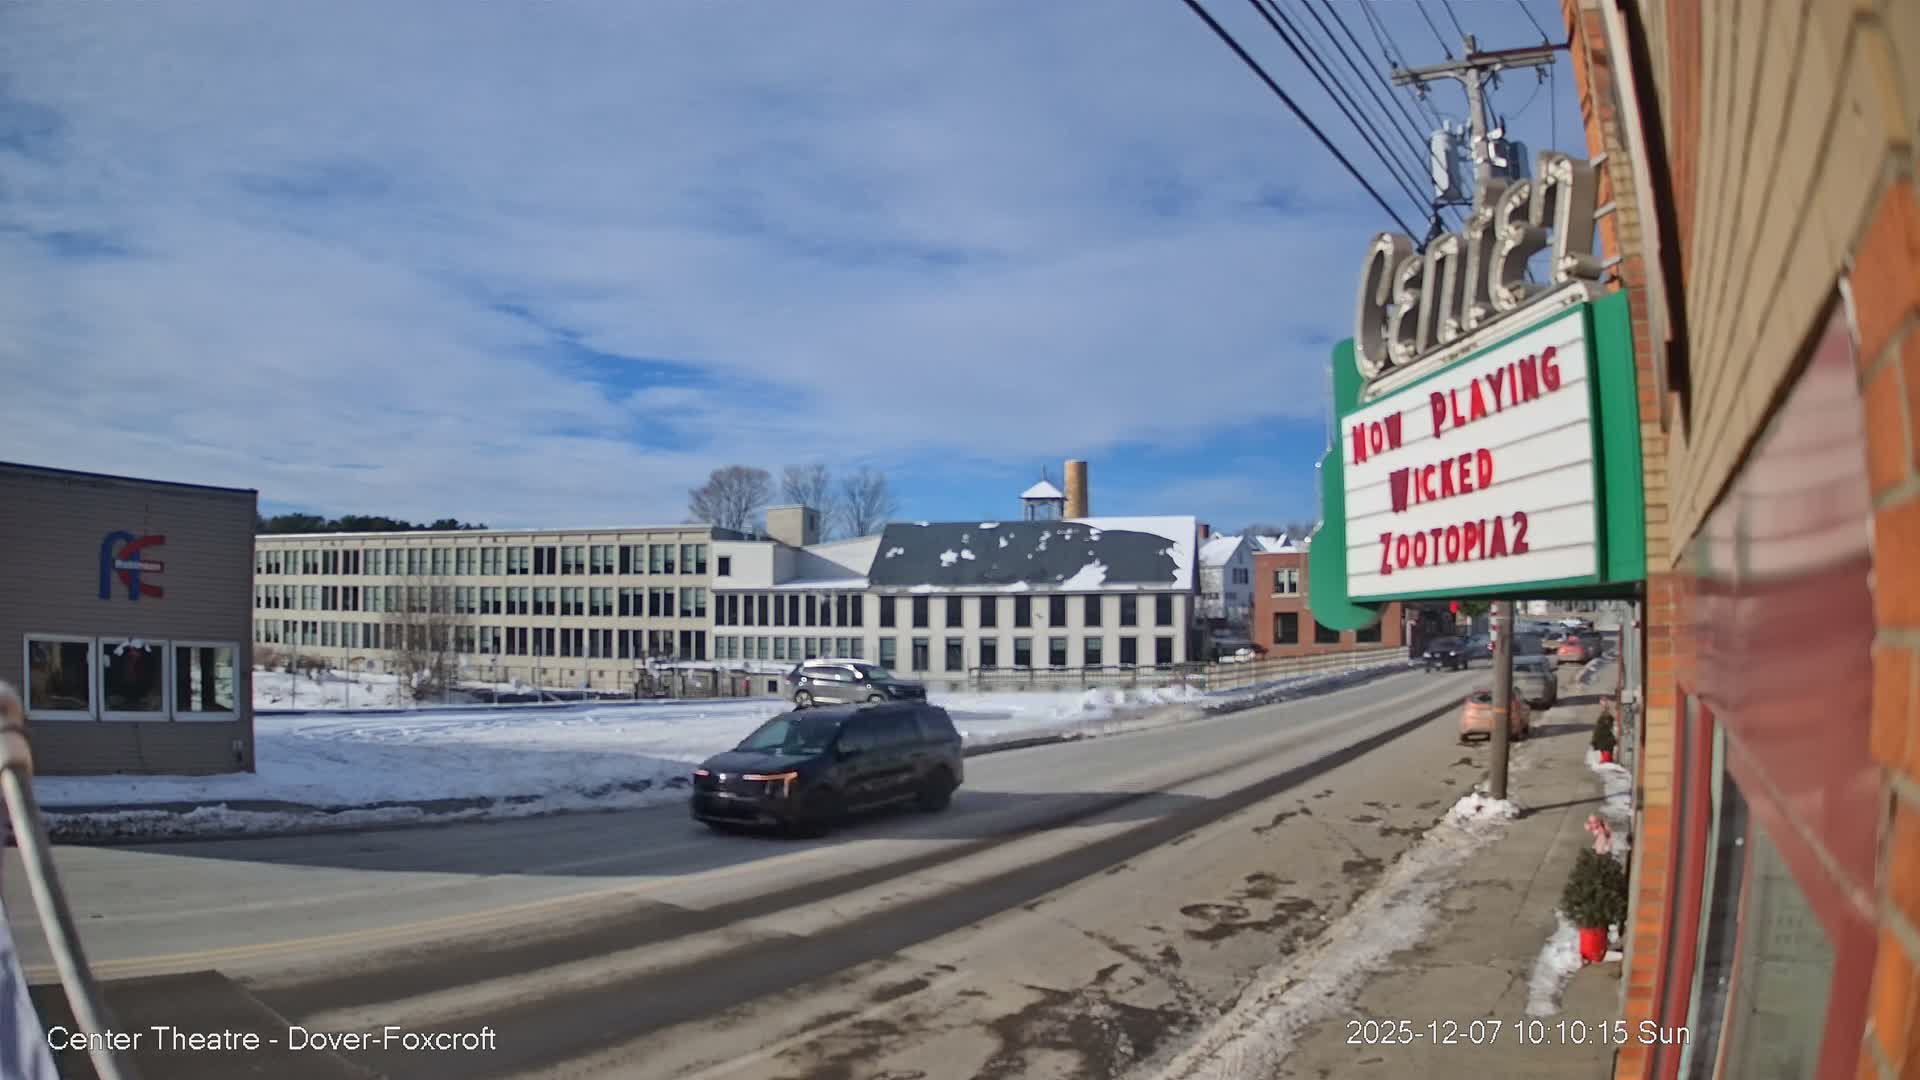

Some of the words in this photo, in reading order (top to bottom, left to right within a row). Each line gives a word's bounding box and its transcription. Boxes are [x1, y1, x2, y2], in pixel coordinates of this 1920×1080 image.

[1352, 411, 1403, 466] NOW
[1430, 346, 1562, 439] PLAYING
[1389, 448, 1494, 513] WICKED
